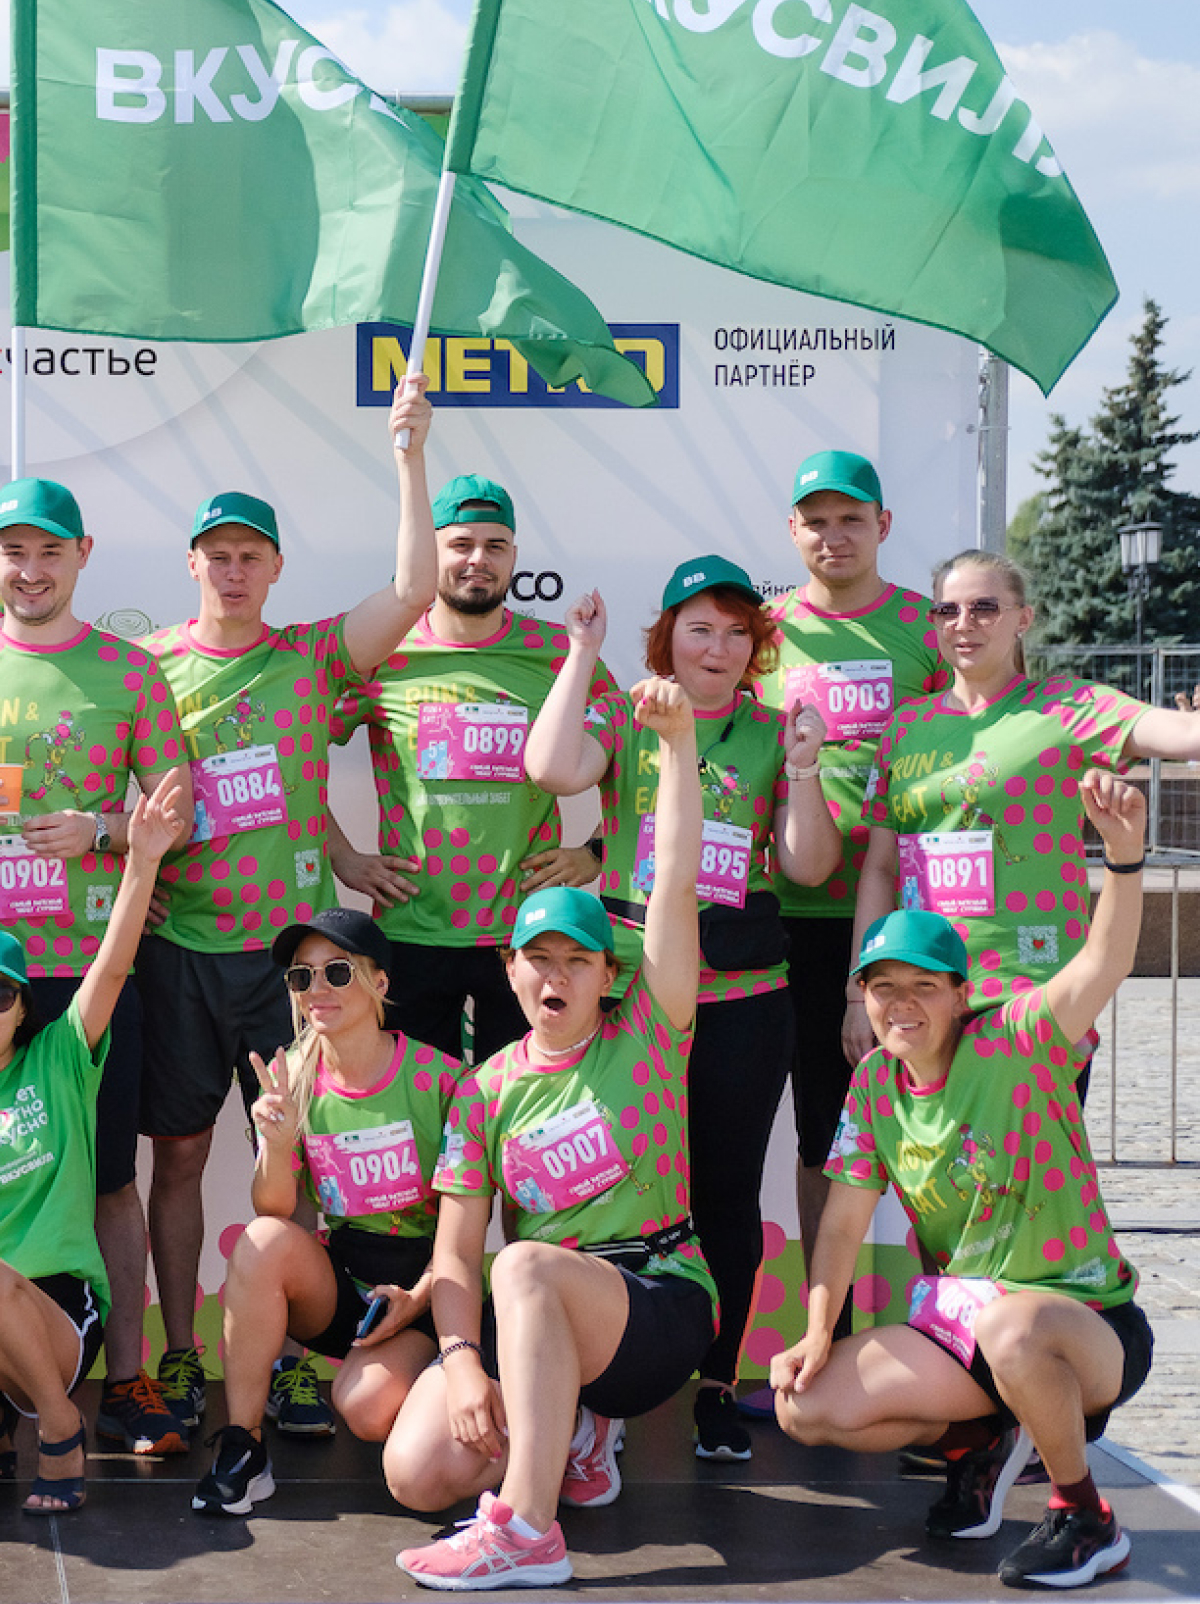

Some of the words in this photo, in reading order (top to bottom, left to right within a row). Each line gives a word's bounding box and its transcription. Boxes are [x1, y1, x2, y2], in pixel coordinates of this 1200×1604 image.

[95, 39, 413, 126] ВКУС
[714, 322, 896, 354] ОФИЦИАЛЬНЫЙ
[714, 358, 816, 388] ПАРТНЁР
[25, 702, 40, 721] &
[829, 682, 891, 713] 0903
[463, 725, 524, 756] 0899
[891, 749, 938, 784] RUN
[939, 751, 954, 768] &
[217, 768, 281, 807] 0884
[892, 785, 928, 822] EAT
[0, 857, 65, 890] 0902
[701, 844, 748, 880] 895
[928, 856, 988, 889] 0891
[350, 1145, 419, 1186] 0904
[542, 1123, 609, 1179] 0907
